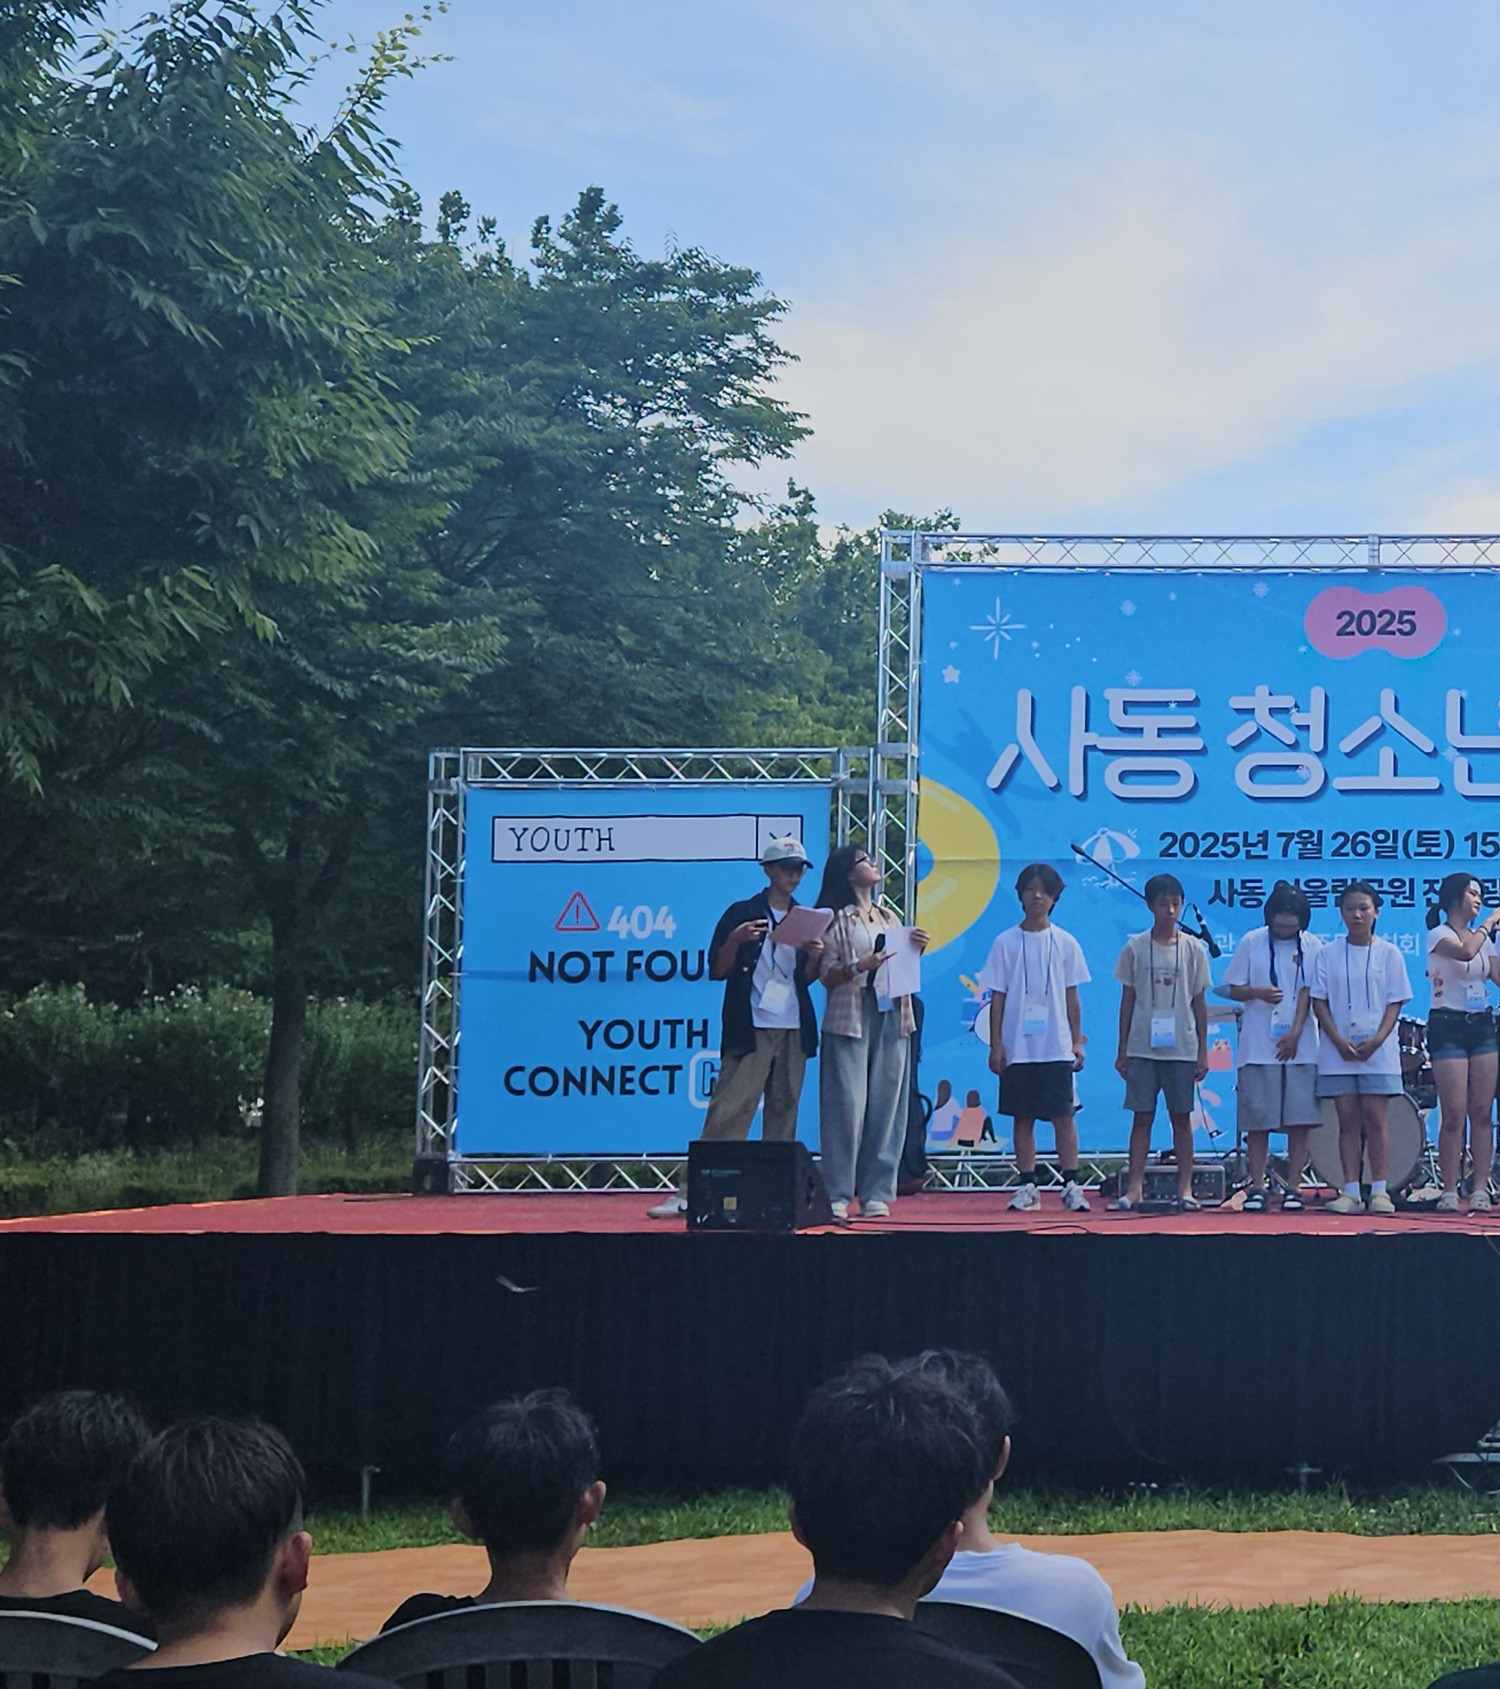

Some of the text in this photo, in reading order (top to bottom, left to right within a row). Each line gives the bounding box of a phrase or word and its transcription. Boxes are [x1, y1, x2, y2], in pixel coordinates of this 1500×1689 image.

[1335, 609, 1417, 637] 2025
[985, 684, 1207, 800] 사동
[508, 826, 616, 853] YOUTH
[1158, 829, 1270, 860] 2025년
[1276, 828, 1324, 858] 7월
[1330, 828, 1456, 859] 26일(토)
[1207, 877, 1267, 909] 사동
[606, 904, 677, 939] 404
[528, 950, 616, 984] NOT
[577, 1018, 709, 1051] YOUTH
[503, 1064, 684, 1097] CONNECT
